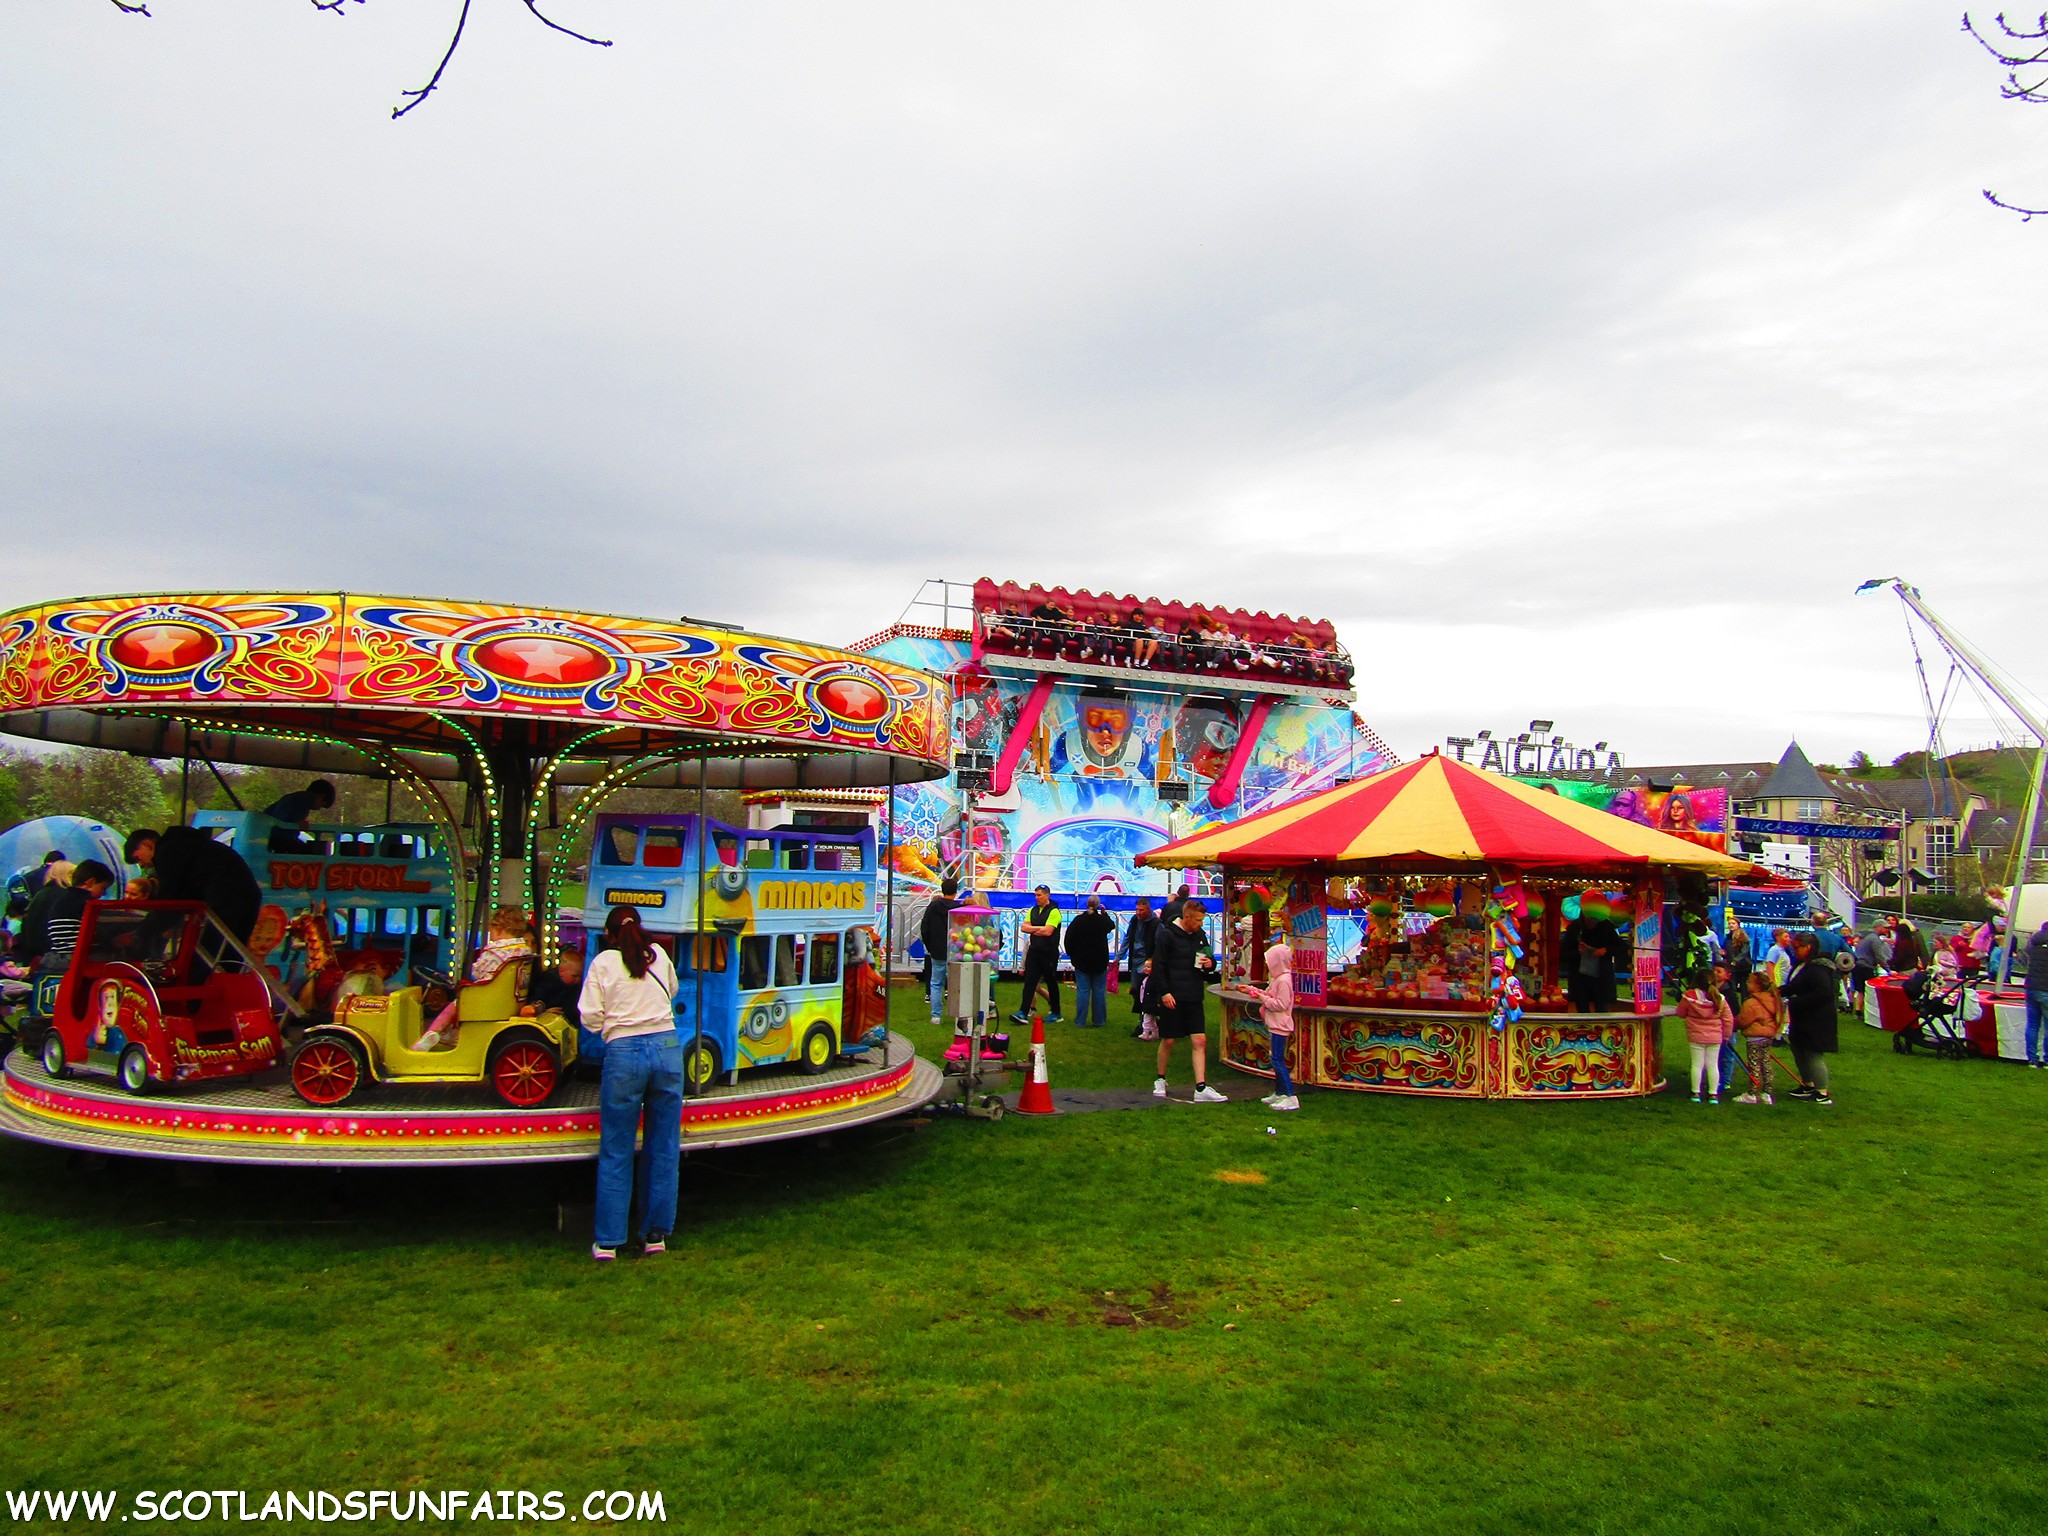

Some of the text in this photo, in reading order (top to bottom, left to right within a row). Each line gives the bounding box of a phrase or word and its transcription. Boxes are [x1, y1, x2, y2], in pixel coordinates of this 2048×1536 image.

[269, 861, 408, 892] TOY STORY
[1291, 905, 1325, 937] PRIZE
[1636, 914, 1660, 945] PRIZE
[1294, 949, 1325, 970] VERY
[1636, 957, 1659, 977] EVERY
[1291, 972, 1322, 995] TIME
[1637, 981, 1658, 1002] TIME
[176, 1035, 274, 1064] Fireman Sam
